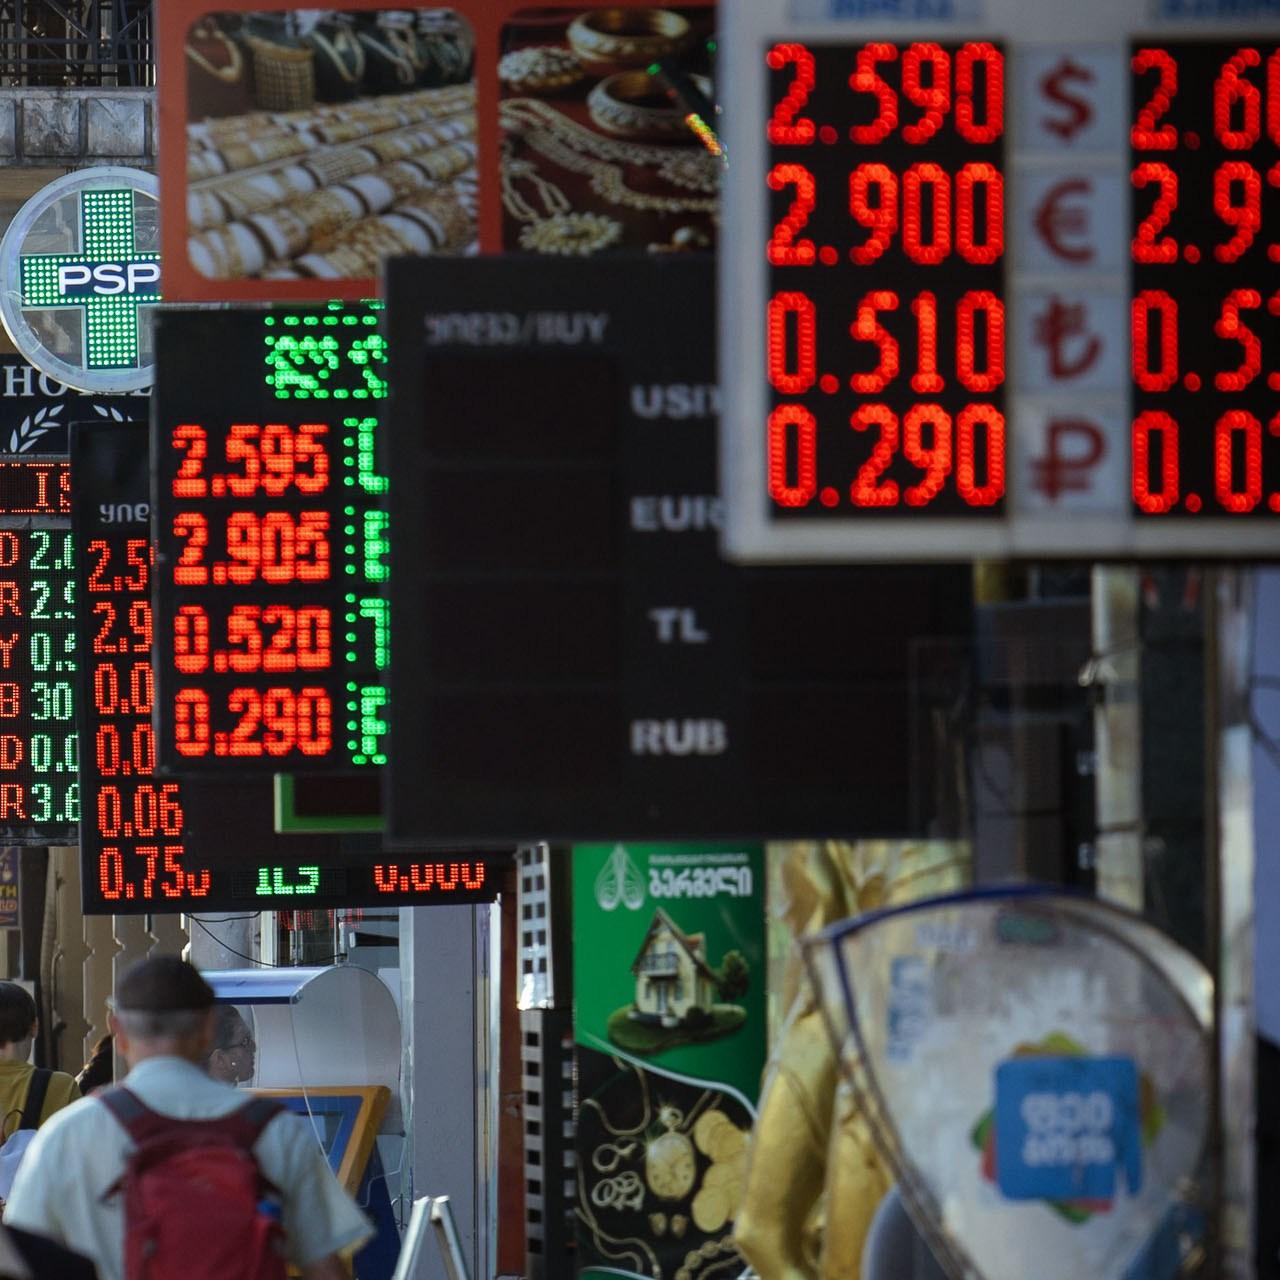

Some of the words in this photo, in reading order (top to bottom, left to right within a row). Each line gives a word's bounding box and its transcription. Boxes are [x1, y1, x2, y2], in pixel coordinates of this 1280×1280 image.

[766, 42, 1004, 146] 2.590
[1038, 56, 1096, 142] $
[1131, 48, 1280, 151] 2.6
[766, 162, 1004, 266] 2.900
[1033, 178, 1094, 263] €
[1131, 161, 1280, 264] 2.9
[58, 263, 161, 296] PSP
[766, 290, 1005, 395] 0.510
[1131, 289, 1280, 393] 0.5
[172, 424, 329, 498] 2.595
[766, 403, 1006, 507] 0.290
[1131, 410, 1280, 513] 0.0
[173, 511, 330, 585] 2.905
[174, 605, 331, 674] 0.520
[649, 608, 708, 643] TL
[174, 687, 332, 757] 0.290
[631, 718, 727, 756] RUB
